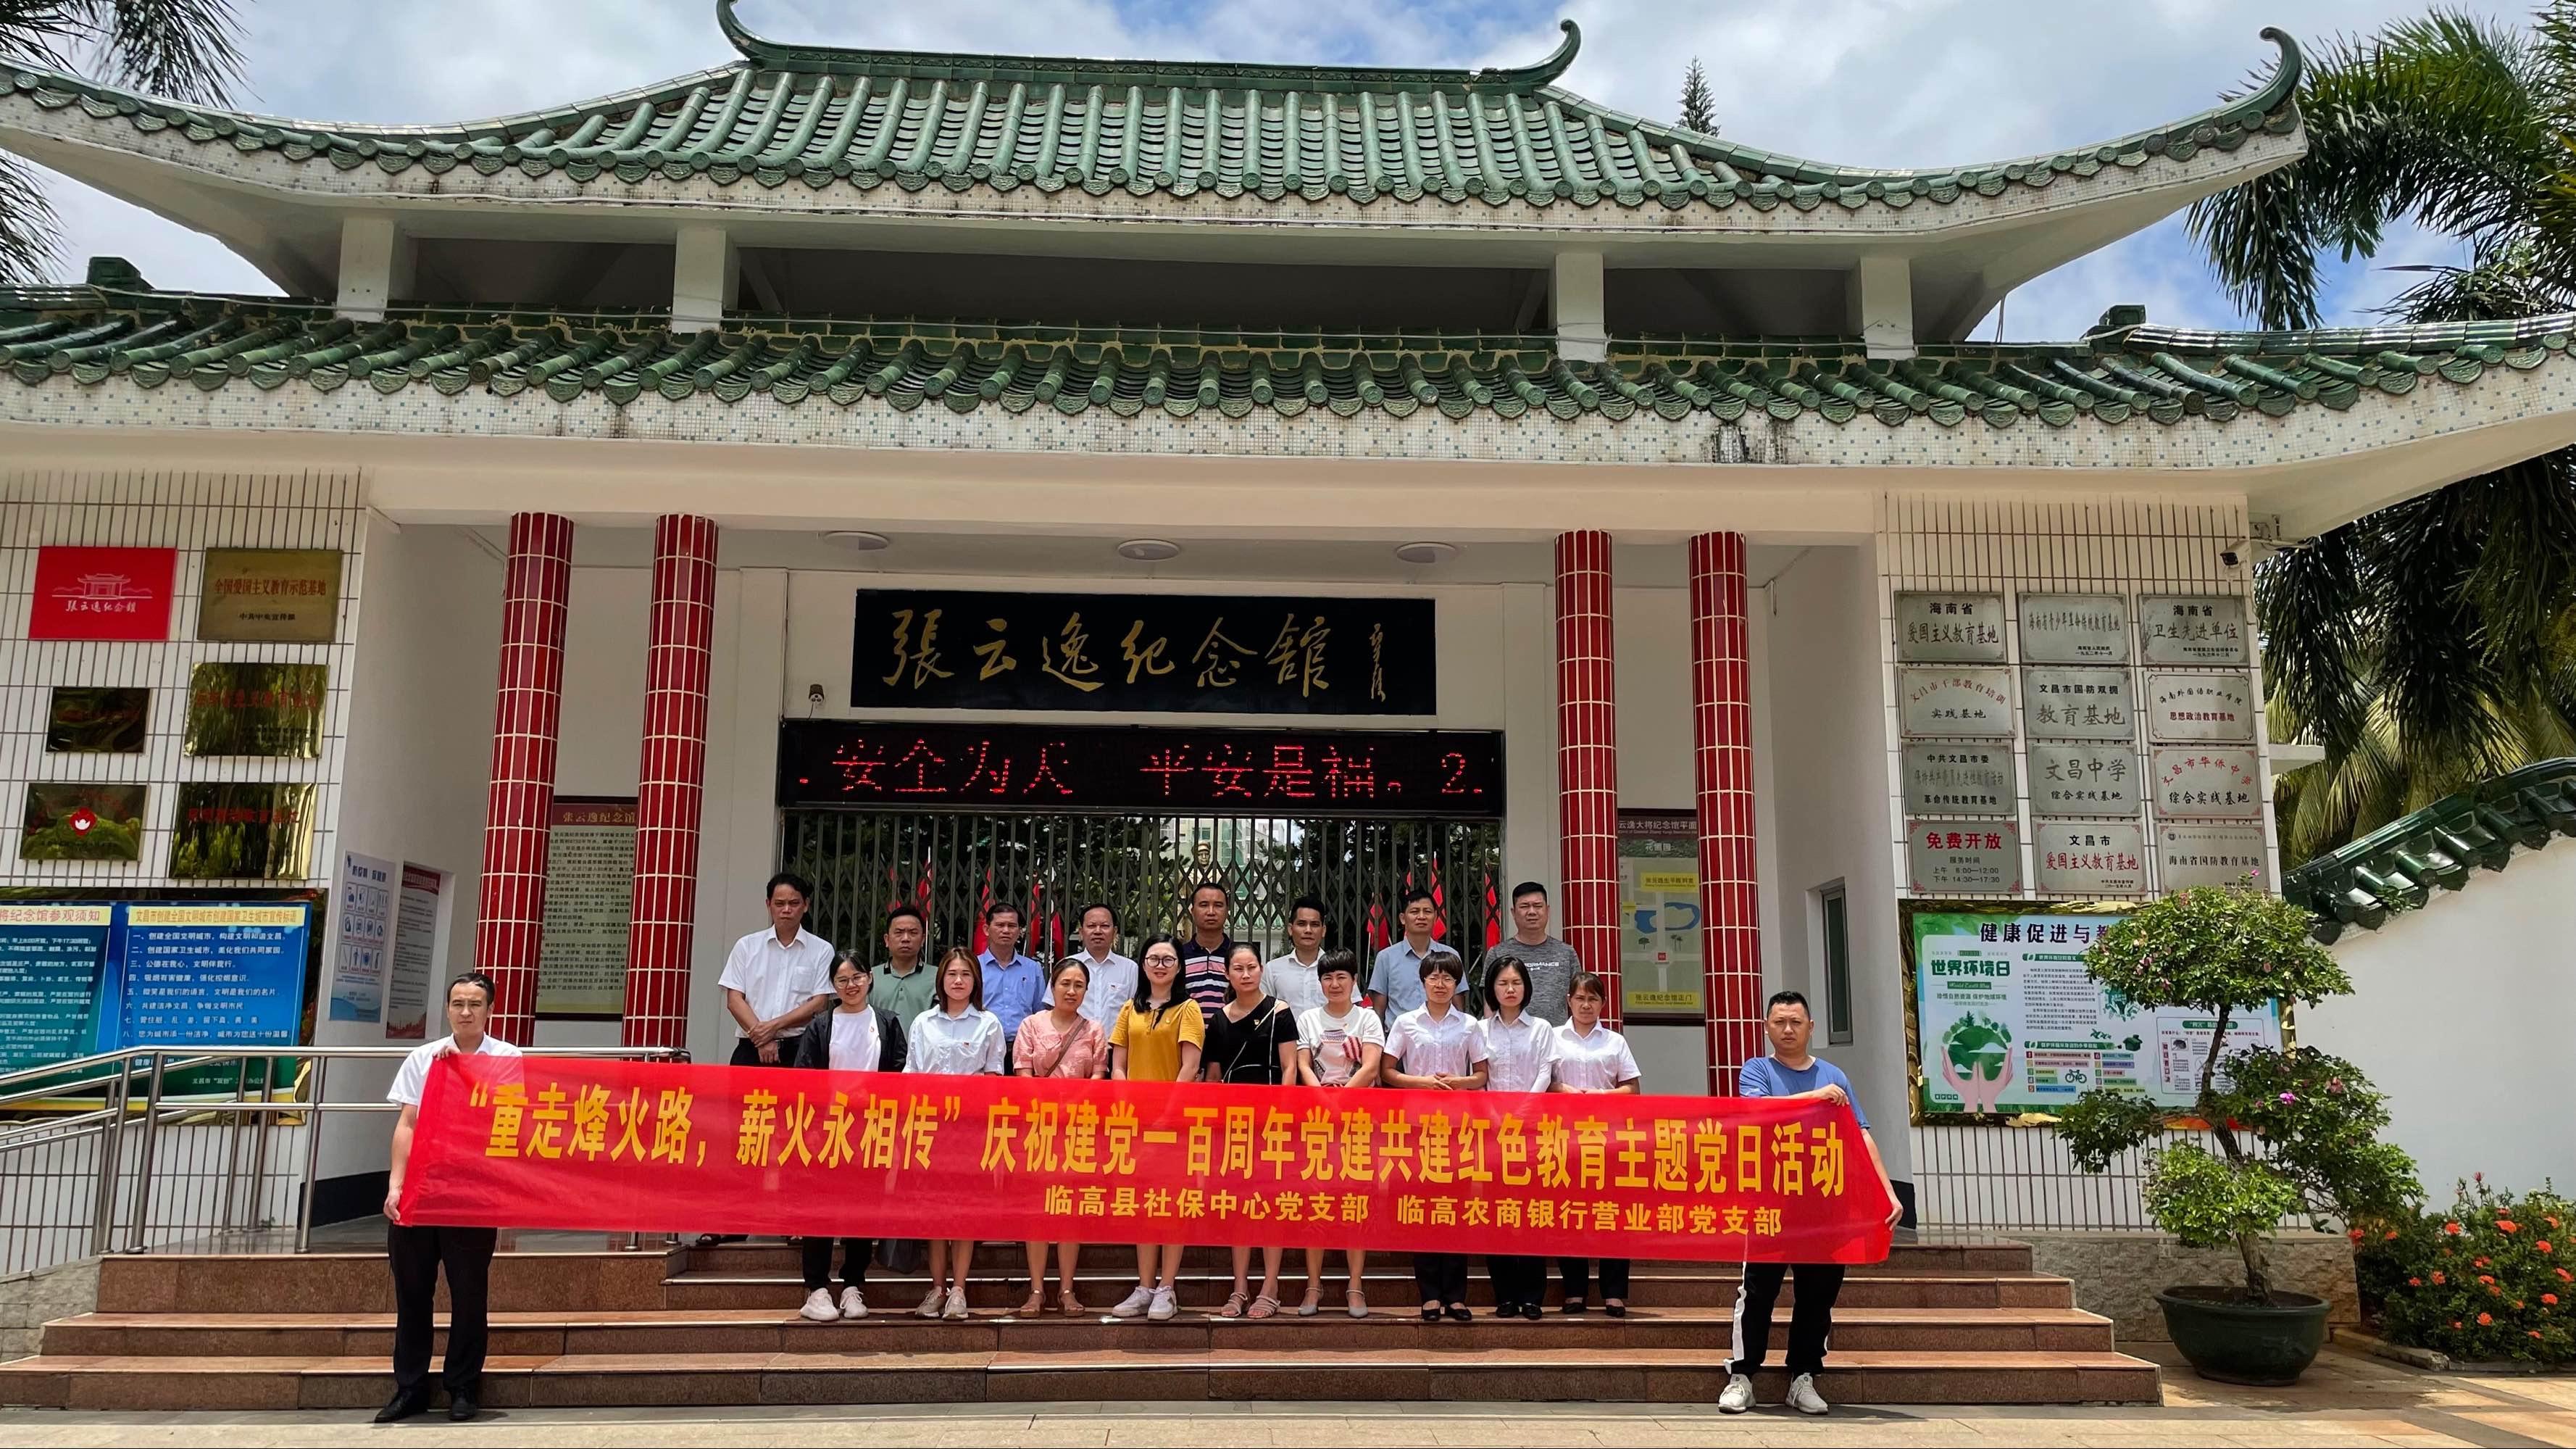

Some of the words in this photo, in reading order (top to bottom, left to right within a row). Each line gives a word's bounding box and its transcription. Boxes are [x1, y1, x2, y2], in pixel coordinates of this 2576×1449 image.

[1929, 602, 1973, 615] 海南省
[2173, 605, 2213, 616] 海南省
[1907, 621, 1999, 646] 爱国主义教育基地
[2153, 621, 2239, 642] 卫生先进单位
[2038, 684, 2119, 694] 文昌市国防双拥
[1931, 707, 1986, 719] 实践基地
[2036, 703, 2126, 727] 教育基地
[2169, 711, 2235, 721] 思想政治教育基地
[1927, 754, 1990, 763] 中共文昌市委
[2045, 757, 2127, 783] 文昌中学
[1924, 794, 1998, 805] 革命传统教育基地
[2168, 791, 2250, 805] 综合实践基地
[1925, 832, 2002, 850] 免费开放
[2069, 834, 2111, 846] 文昌市
[2046, 852, 2139, 872] 爱国主义教育基地
[2169, 855, 2260, 867] 海南省国防教育基地
[1930, 959, 2011, 977] 世界环境日
[1044, 1184, 1369, 1223] 临高县社保中心党支部
[1397, 1197, 1783, 1239] 临高农商银行营业部党支部
